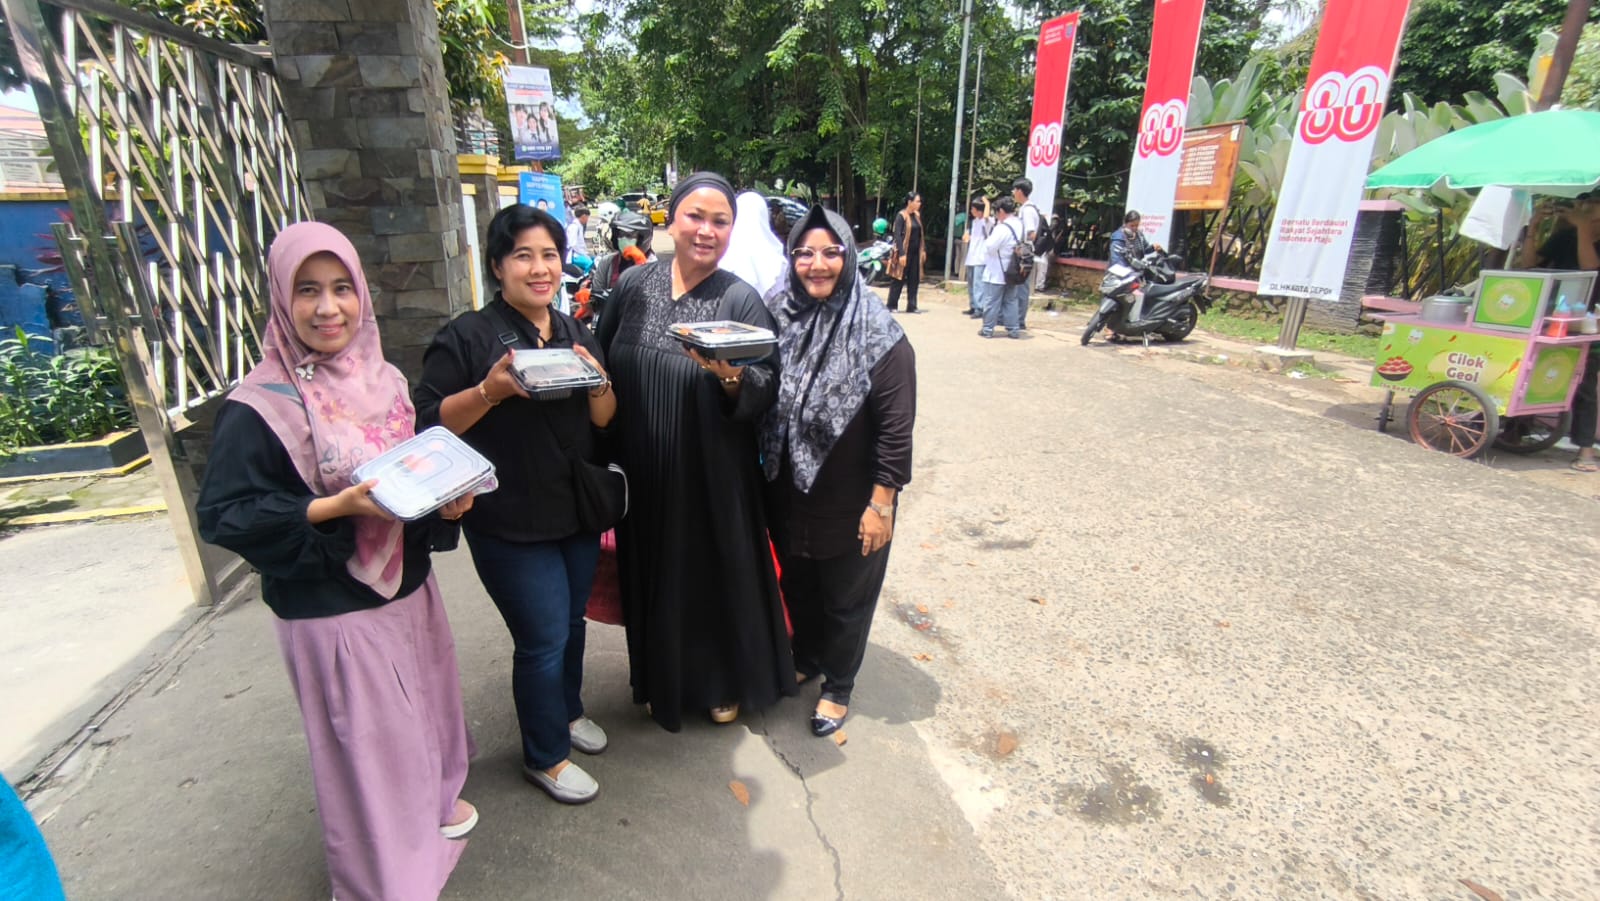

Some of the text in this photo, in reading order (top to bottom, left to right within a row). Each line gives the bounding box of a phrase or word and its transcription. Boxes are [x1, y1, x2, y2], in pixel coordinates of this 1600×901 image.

[1301, 66, 1387, 145] 80
[1138, 99, 1186, 158] 80
[1030, 123, 1062, 167] 80
[1280, 227, 1343, 236] Rakyat Sejahtera
[1313, 236, 1333, 244] Maju
[1447, 352, 1486, 369] Cilok
[1446, 367, 1479, 382] Geol
